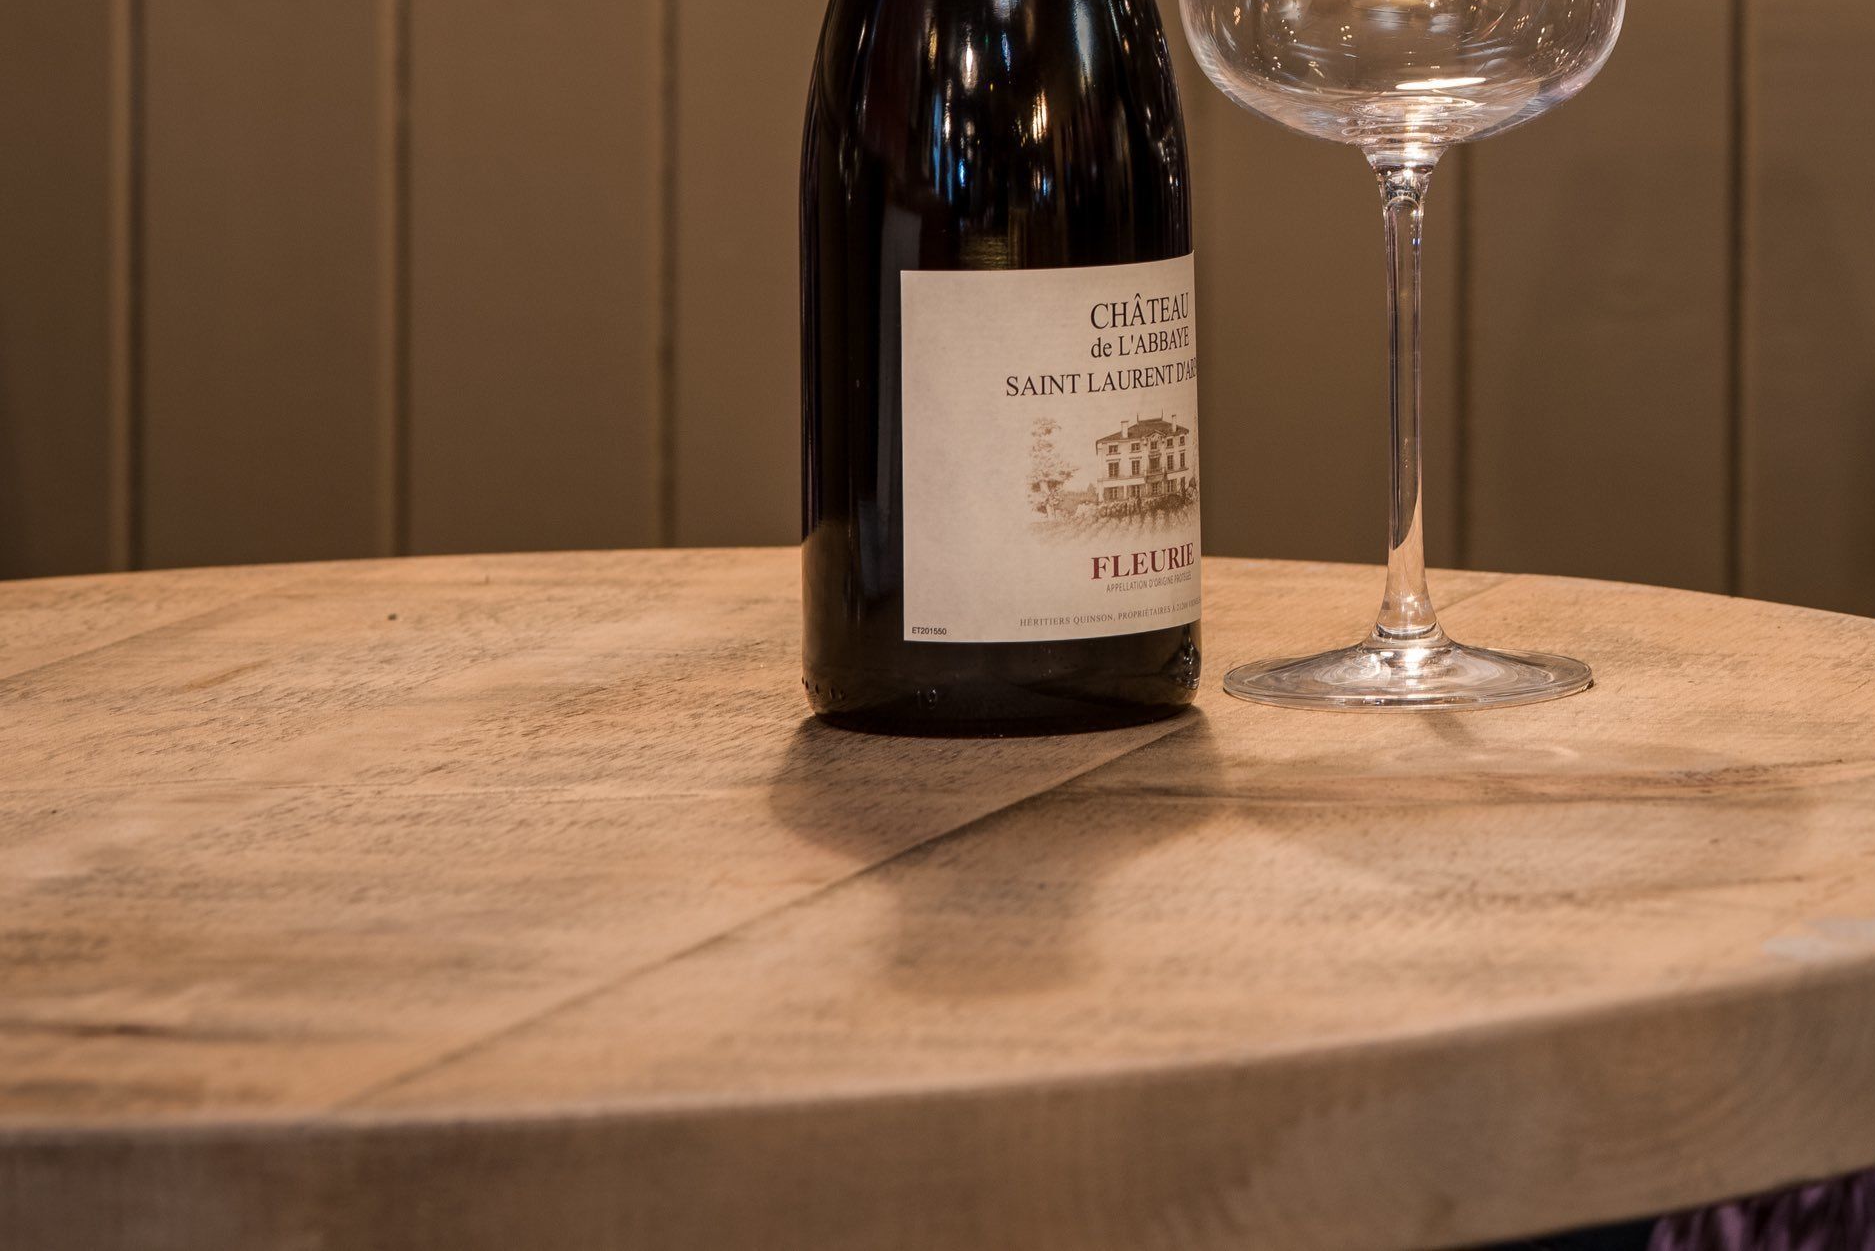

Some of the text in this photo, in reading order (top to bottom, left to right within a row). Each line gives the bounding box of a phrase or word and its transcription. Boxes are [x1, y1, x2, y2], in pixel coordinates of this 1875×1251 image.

[1090, 292, 1189, 329] CHÂTEAU
[1091, 326, 1189, 358] de L'ABBAYE
[1006, 374, 1080, 397] SAINT
[1088, 363, 1173, 393] LAURENT
[1091, 542, 1194, 580] FLEURIE
[1106, 580, 1147, 593] APPELLATION
[1149, 575, 1174, 589] D'ORIGINE
[1020, 616, 1070, 627] HÉRITIERS
[1073, 613, 1116, 625] QUINSON,
[1118, 606, 1171, 621] PROPRIÉTAIRES
